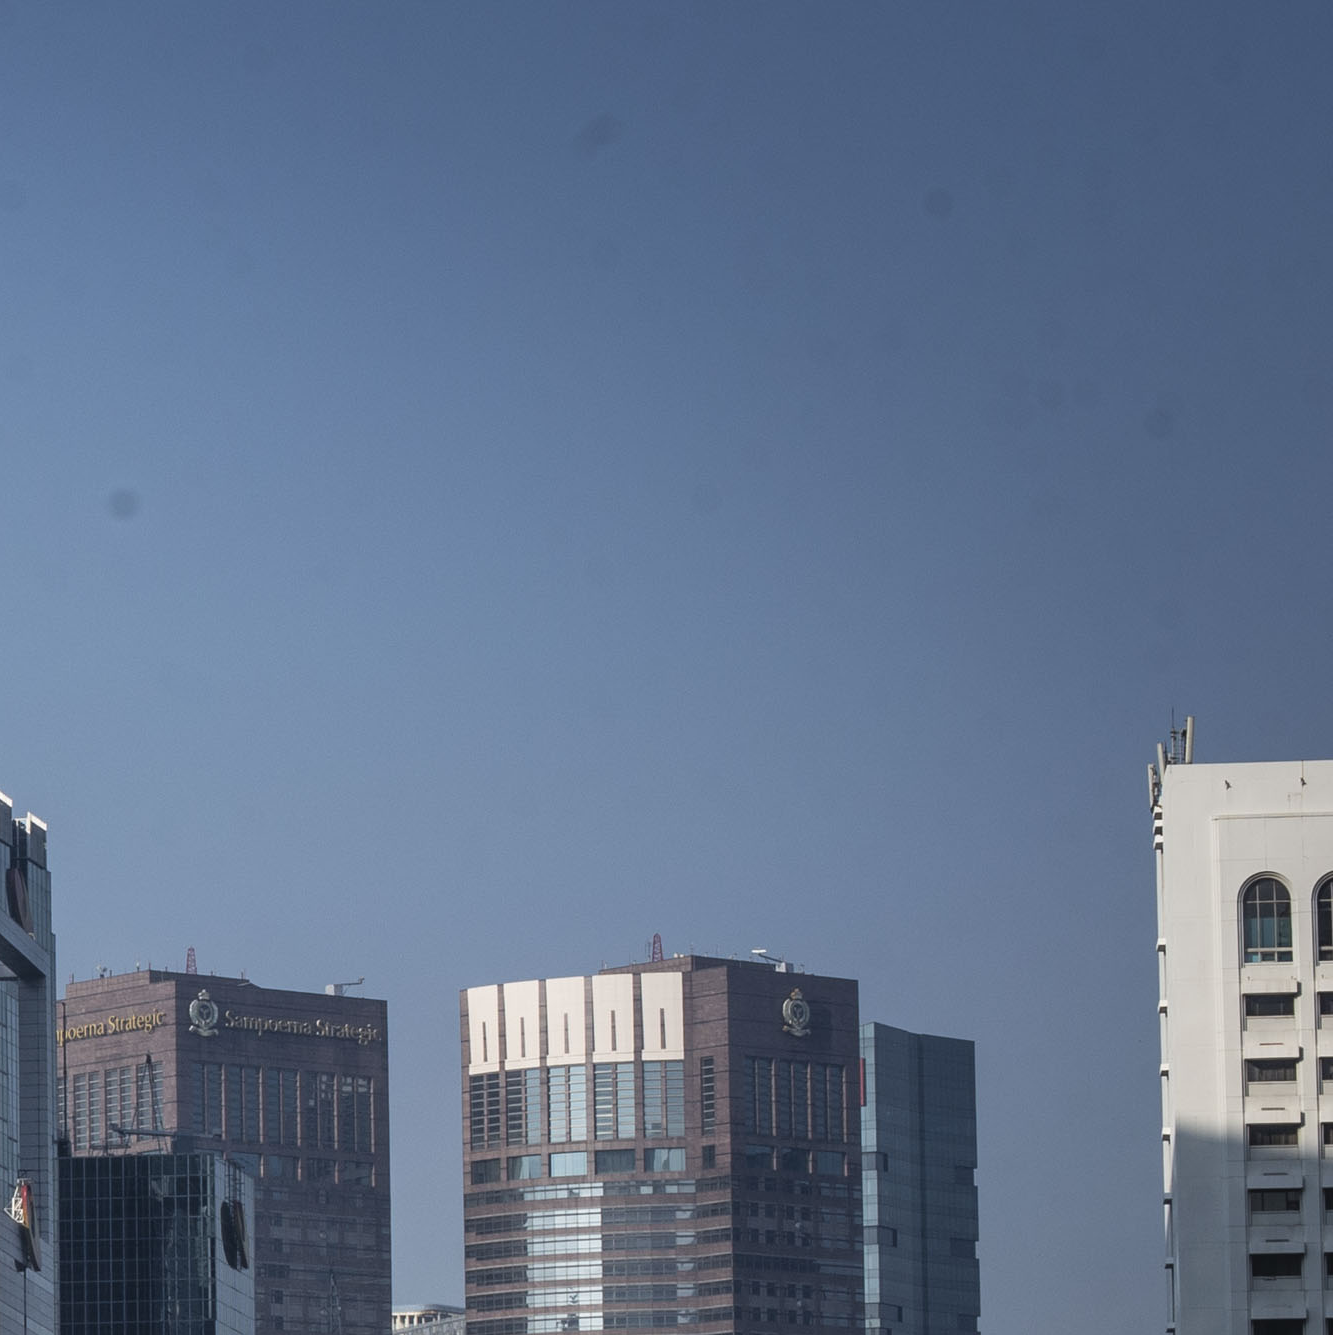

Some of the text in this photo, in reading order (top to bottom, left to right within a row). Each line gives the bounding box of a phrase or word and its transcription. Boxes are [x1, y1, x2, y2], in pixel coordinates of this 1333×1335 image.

[56, 1008, 166, 1047] poerna Strategic
[225, 1010, 382, 1044] Sampoerna Strategic
